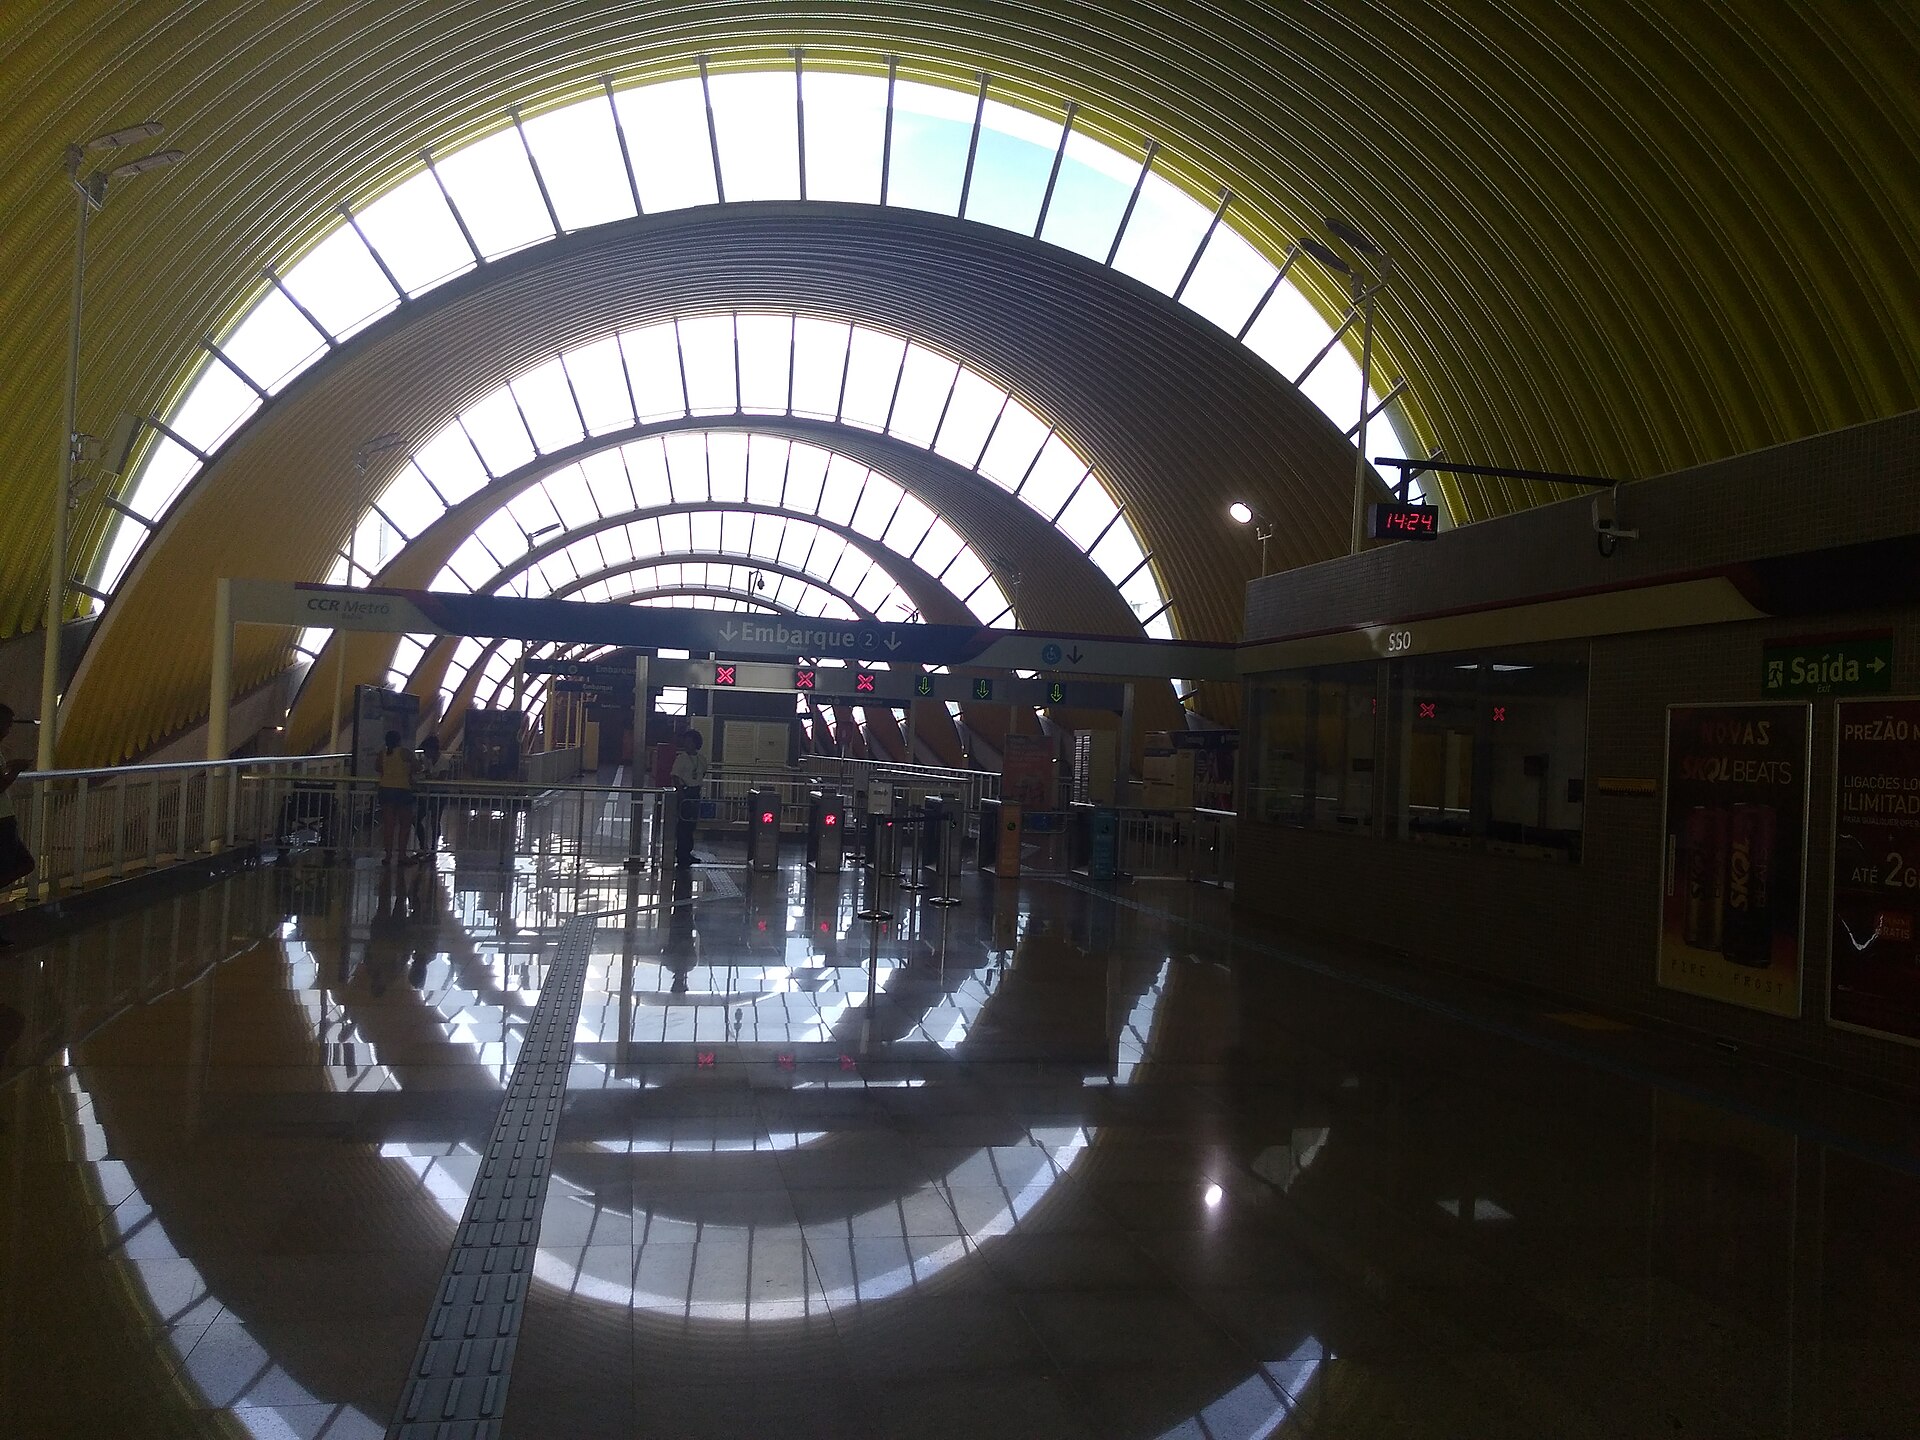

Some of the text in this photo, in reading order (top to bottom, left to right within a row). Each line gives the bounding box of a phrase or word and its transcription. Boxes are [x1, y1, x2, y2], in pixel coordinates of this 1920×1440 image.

[1386, 513, 1433, 531] 14:24
[307, 598, 340, 611] CCR
[741, 621, 855, 651] Embarque
[1388, 631, 1411, 651] SSO
[1790, 653, 1860, 685] Saída
[1702, 720, 1770, 745] NOVAS
[1844, 715, 1908, 741] PREZÃO
[1681, 757, 1792, 785] SKOL BEATS
[1843, 774, 1900, 792] LIGAÇÕES
[1730, 837, 1750, 911] SKOL
[1851, 852, 1920, 888] ATÉ 2G
[1734, 973, 1783, 996] FROST
